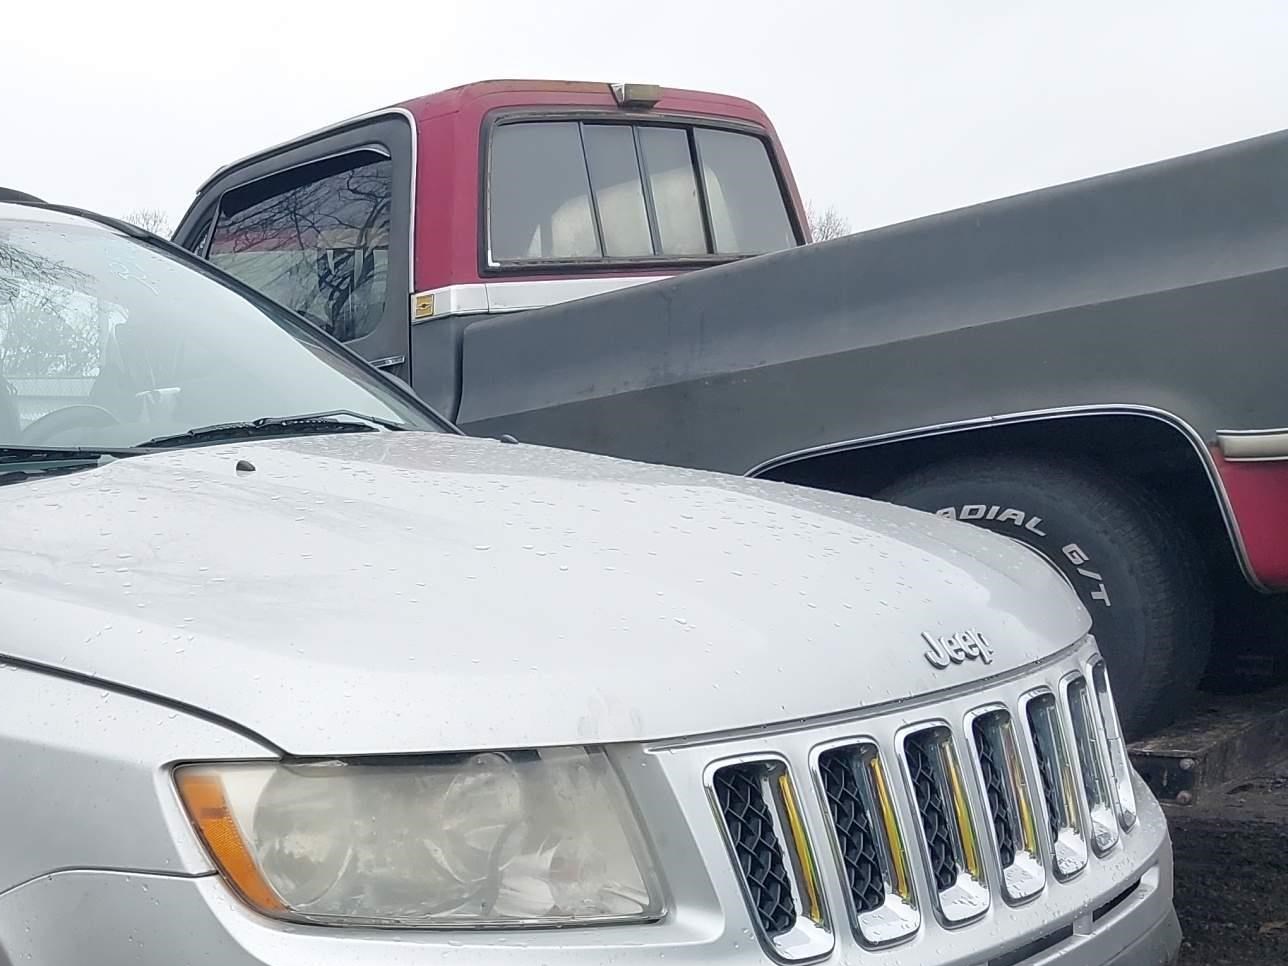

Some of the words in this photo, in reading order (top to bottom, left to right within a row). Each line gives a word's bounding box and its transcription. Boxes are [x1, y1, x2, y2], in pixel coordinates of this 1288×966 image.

[935, 504, 1047, 537] ADIAL
[1062, 543, 1111, 607] G/T
[921, 627, 994, 670] Jeep
